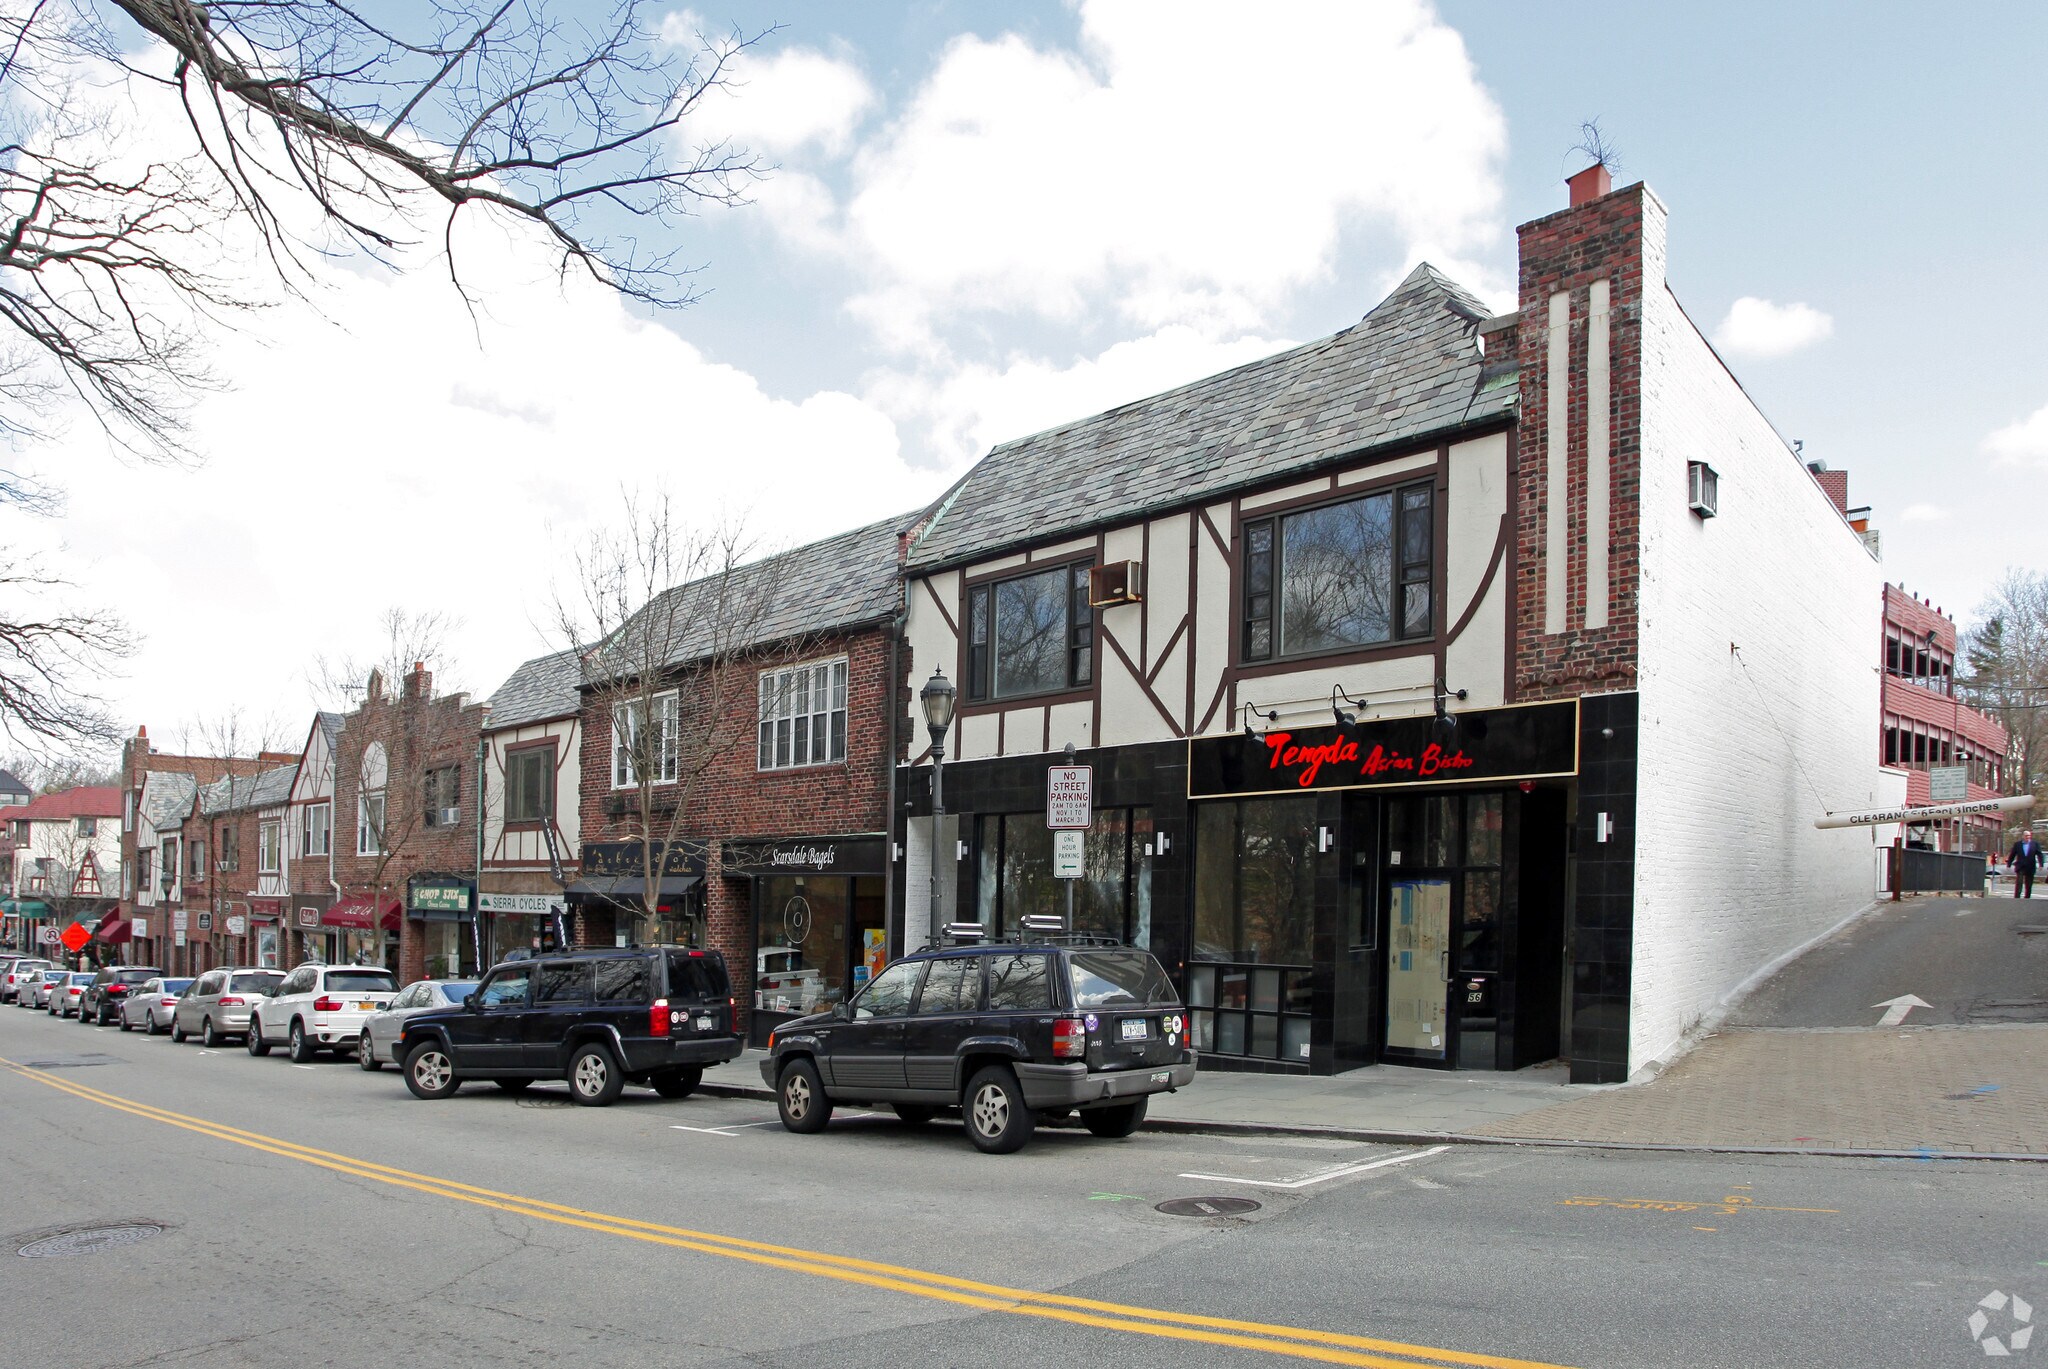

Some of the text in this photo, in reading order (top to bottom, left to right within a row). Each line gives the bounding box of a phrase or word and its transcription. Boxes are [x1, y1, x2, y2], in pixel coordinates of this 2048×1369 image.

[1265, 733, 1473, 786] Tengda Asian Bistro
[1063, 771, 1077, 781] NO
[1053, 782, 1086, 791] STREET
[1050, 793, 1088, 801] PARKING
[771, 844, 835, 871] Scarsdale Bagels
[420, 889, 440, 900] CHOP
[442, 889, 460, 900] STIX
[493, 897, 517, 909] SIERRA
[519, 898, 547, 910] CYCLES
[1469, 993, 1481, 1002] 56
